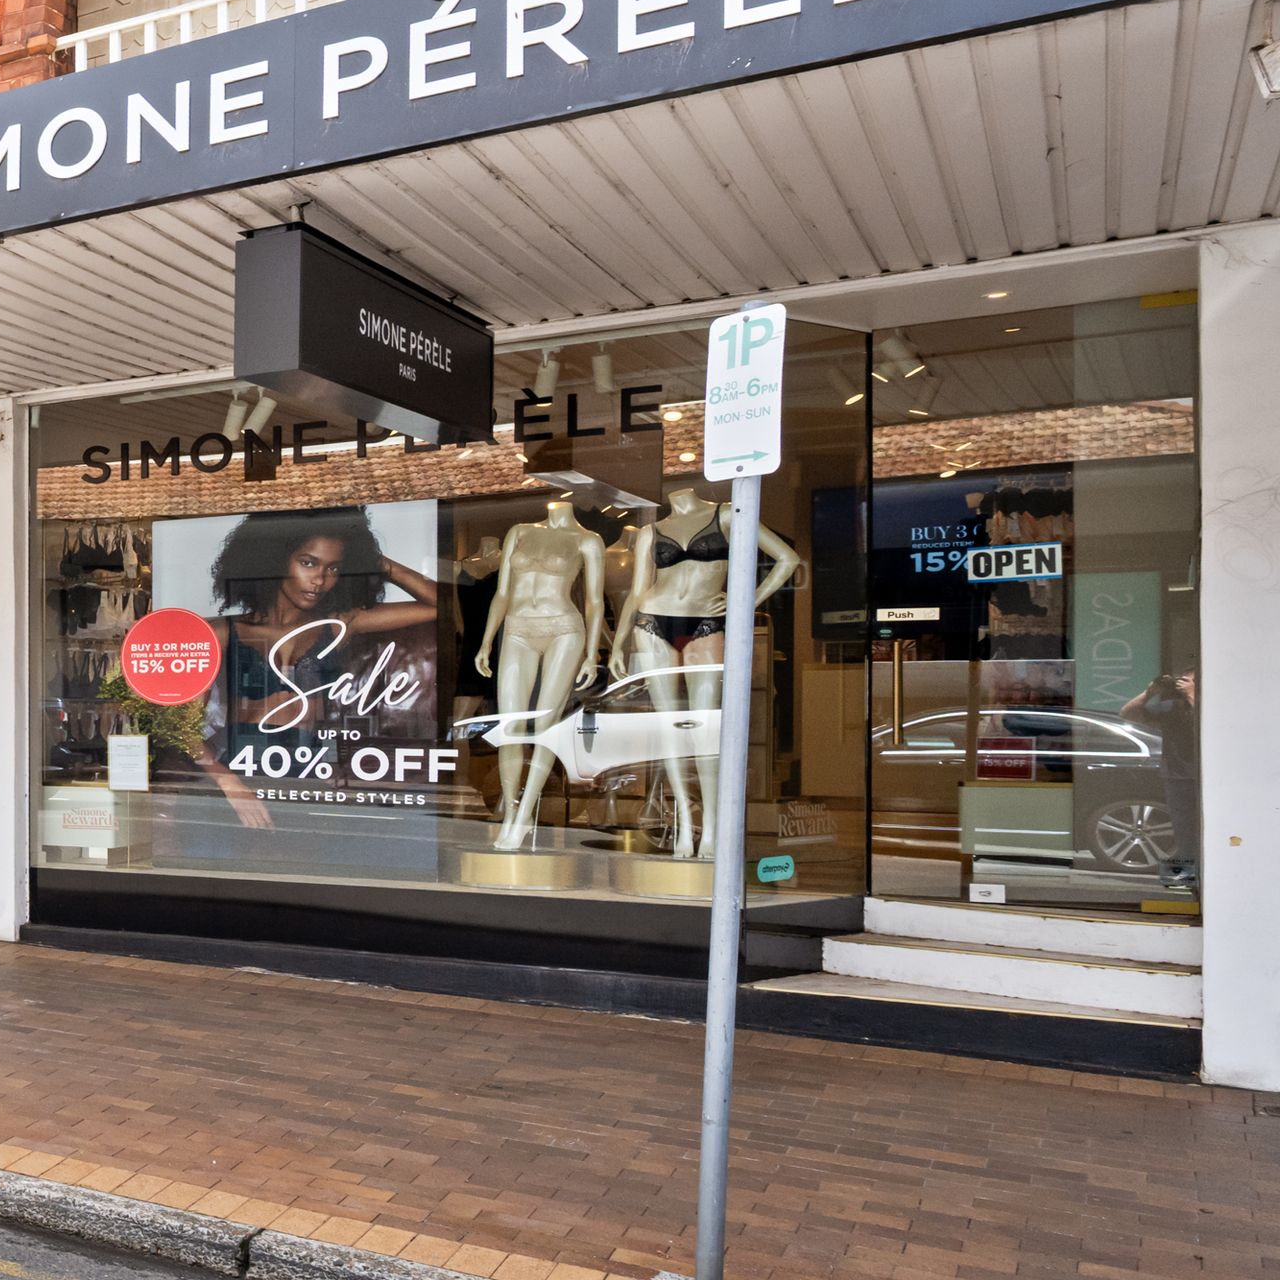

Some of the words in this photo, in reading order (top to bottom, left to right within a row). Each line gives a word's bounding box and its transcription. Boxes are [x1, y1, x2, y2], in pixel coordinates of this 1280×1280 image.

[359, 307, 407, 353] SIMONE
[409, 330, 453, 374] PÉRÈLE
[718, 317, 775, 370] 1P
[399, 363, 417, 382] PARIS
[80, 420, 328, 485] SIMONE
[911, 525, 951, 541] BUY
[956, 524, 968, 538] 3
[912, 541, 951, 549] REDUCED
[972, 547, 1056, 578] OPEN
[887, 611, 914, 619] Push
[130, 643, 151, 652] BUY
[153, 643, 160, 651] 3
[162, 643, 178, 651] OR
[180, 642, 210, 651] MORE
[131, 659, 165, 673] 15%
[170, 659, 210, 673] OFF
[258, 619, 420, 734] Sale
[317, 729, 337, 741] UP
[340, 730, 361, 741] TO
[228, 745, 333, 780] 40%
[350, 747, 459, 783] OFF
[1004, 759, 1026, 768] OFF
[256, 789, 347, 802] SELECTED
[356, 792, 426, 805] STYLES
[71, 807, 108, 817] Simone
[787, 800, 827, 818] Simone
[778, 813, 838, 837] Rewards
